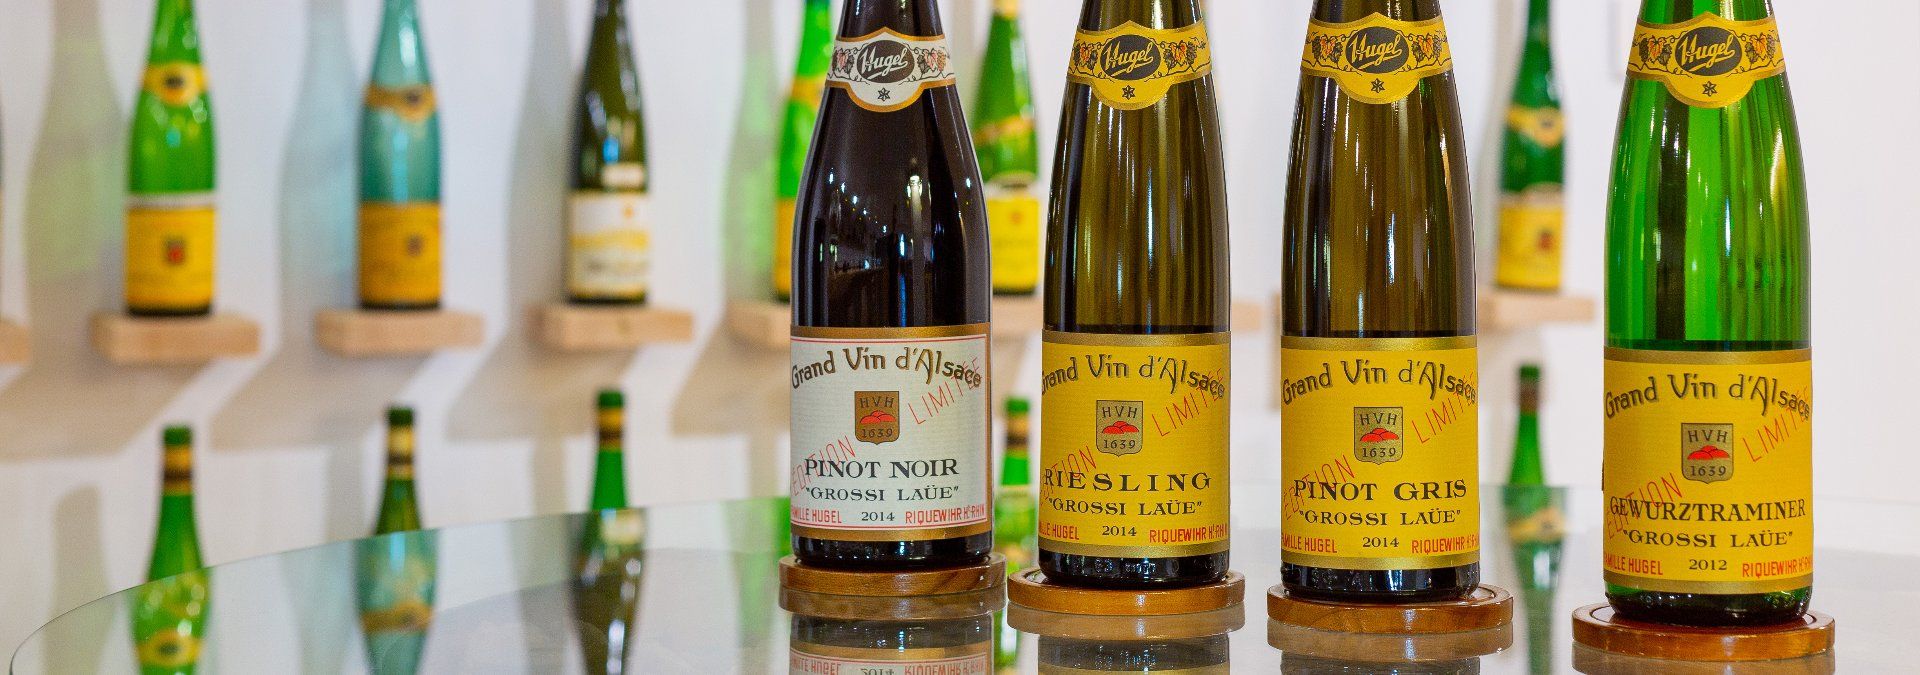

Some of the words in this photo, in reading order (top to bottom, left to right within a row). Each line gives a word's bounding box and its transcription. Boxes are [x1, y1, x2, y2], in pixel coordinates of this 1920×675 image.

[1102, 41, 1154, 76] Hugel
[1349, 33, 1403, 69] Hugel
[1680, 34, 1735, 71] Hugel
[860, 46, 908, 79] Hugel
[791, 350, 835, 389] Grand
[843, 347, 886, 370] Vin
[896, 347, 981, 388] d'Alsace
[1086, 354, 1129, 378] Vin
[1139, 356, 1225, 398] d'Alsace
[1282, 363, 1332, 405] Grand
[1341, 359, 1386, 384] Vin
[1398, 360, 1476, 404] d'Alsace
[860, 397, 894, 408] HVH
[1605, 376, 1658, 418] Grand
[1667, 373, 1715, 399] Vin
[1729, 374, 1810, 420] d'Alsace
[1102, 406, 1137, 418] HVH
[1359, 413, 1398, 425] HVH
[861, 428, 893, 438] 1639
[1687, 429, 1728, 443] HVH
[1104, 439, 1135, 449] 1639
[1362, 447, 1396, 458] 1639
[805, 458, 880, 478] PINOT
[890, 458, 959, 478] NOIR
[1690, 465, 1726, 477] 1639
[1044, 469, 1211, 492] RIESLING
[1294, 479, 1377, 500] PINOT
[1394, 479, 1467, 500] GRIS
[806, 486, 885, 501] "GROSSI
[898, 485, 959, 501] LAÜE"
[812, 509, 842, 524] HUGEL
[861, 511, 895, 521] 2014
[905, 508, 961, 525] RIQUEWIHR
[1049, 498, 1126, 515] "GROSSI
[1138, 500, 1203, 516] LAÜE"
[1299, 509, 1387, 525] "GROSSI
[1400, 508, 1461, 525] LAÜE"
[1610, 496, 1806, 521] GEWURZTRAMINER
[1052, 524, 1079, 540] HUGEL
[1102, 526, 1137, 536] 2014
[1150, 527, 1206, 544] RIQUEWIHR
[1623, 529, 1716, 547] "GROSSI
[1731, 529, 1793, 548] LAÜE"
[1304, 537, 1337, 553] HUGEL
[1362, 537, 1399, 548] 2014
[1412, 537, 1465, 555] RIQUEWIHR
[1628, 558, 1663, 575] HUGEL
[1689, 559, 1728, 571] 2012
[1742, 560, 1797, 578] RIQUEWIHR
